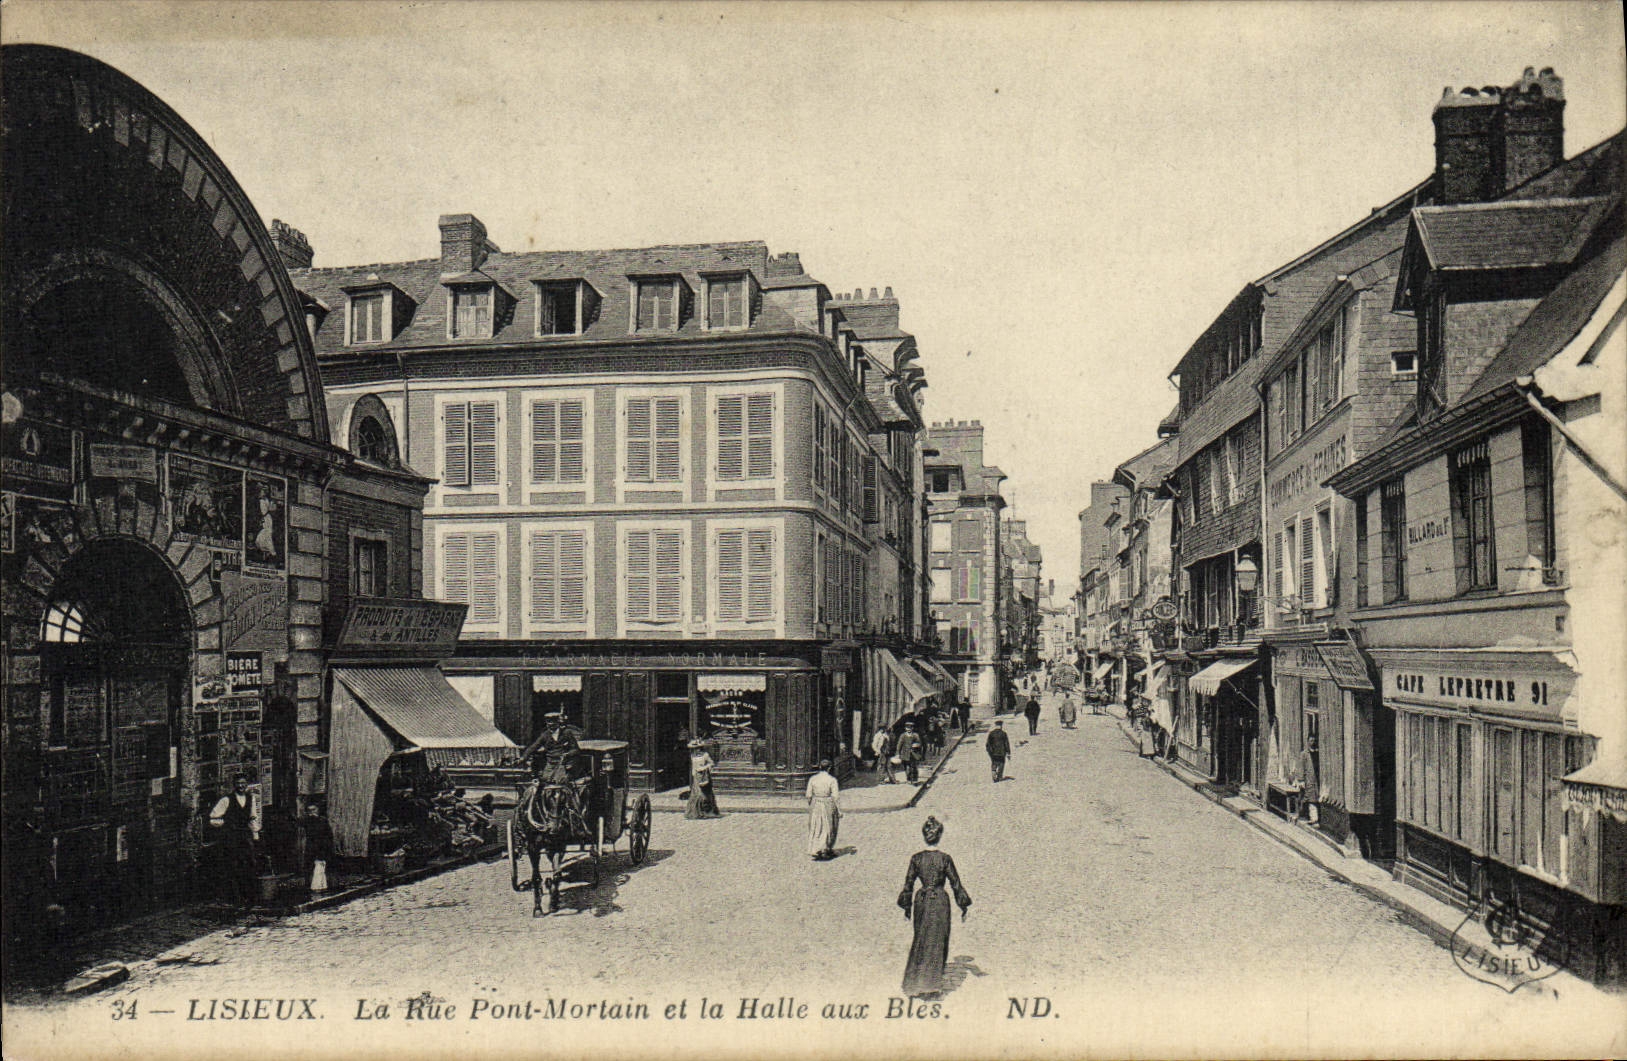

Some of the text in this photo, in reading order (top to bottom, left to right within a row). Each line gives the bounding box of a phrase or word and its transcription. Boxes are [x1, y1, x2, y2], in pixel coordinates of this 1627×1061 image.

[1313, 434, 1346, 481] GRAINES
[353, 606, 404, 626] PRODUITS
[394, 629, 441, 643] ANTILLES
[667, 652, 768, 667] NORMALE
[1532, 682, 1549, 706] 91
